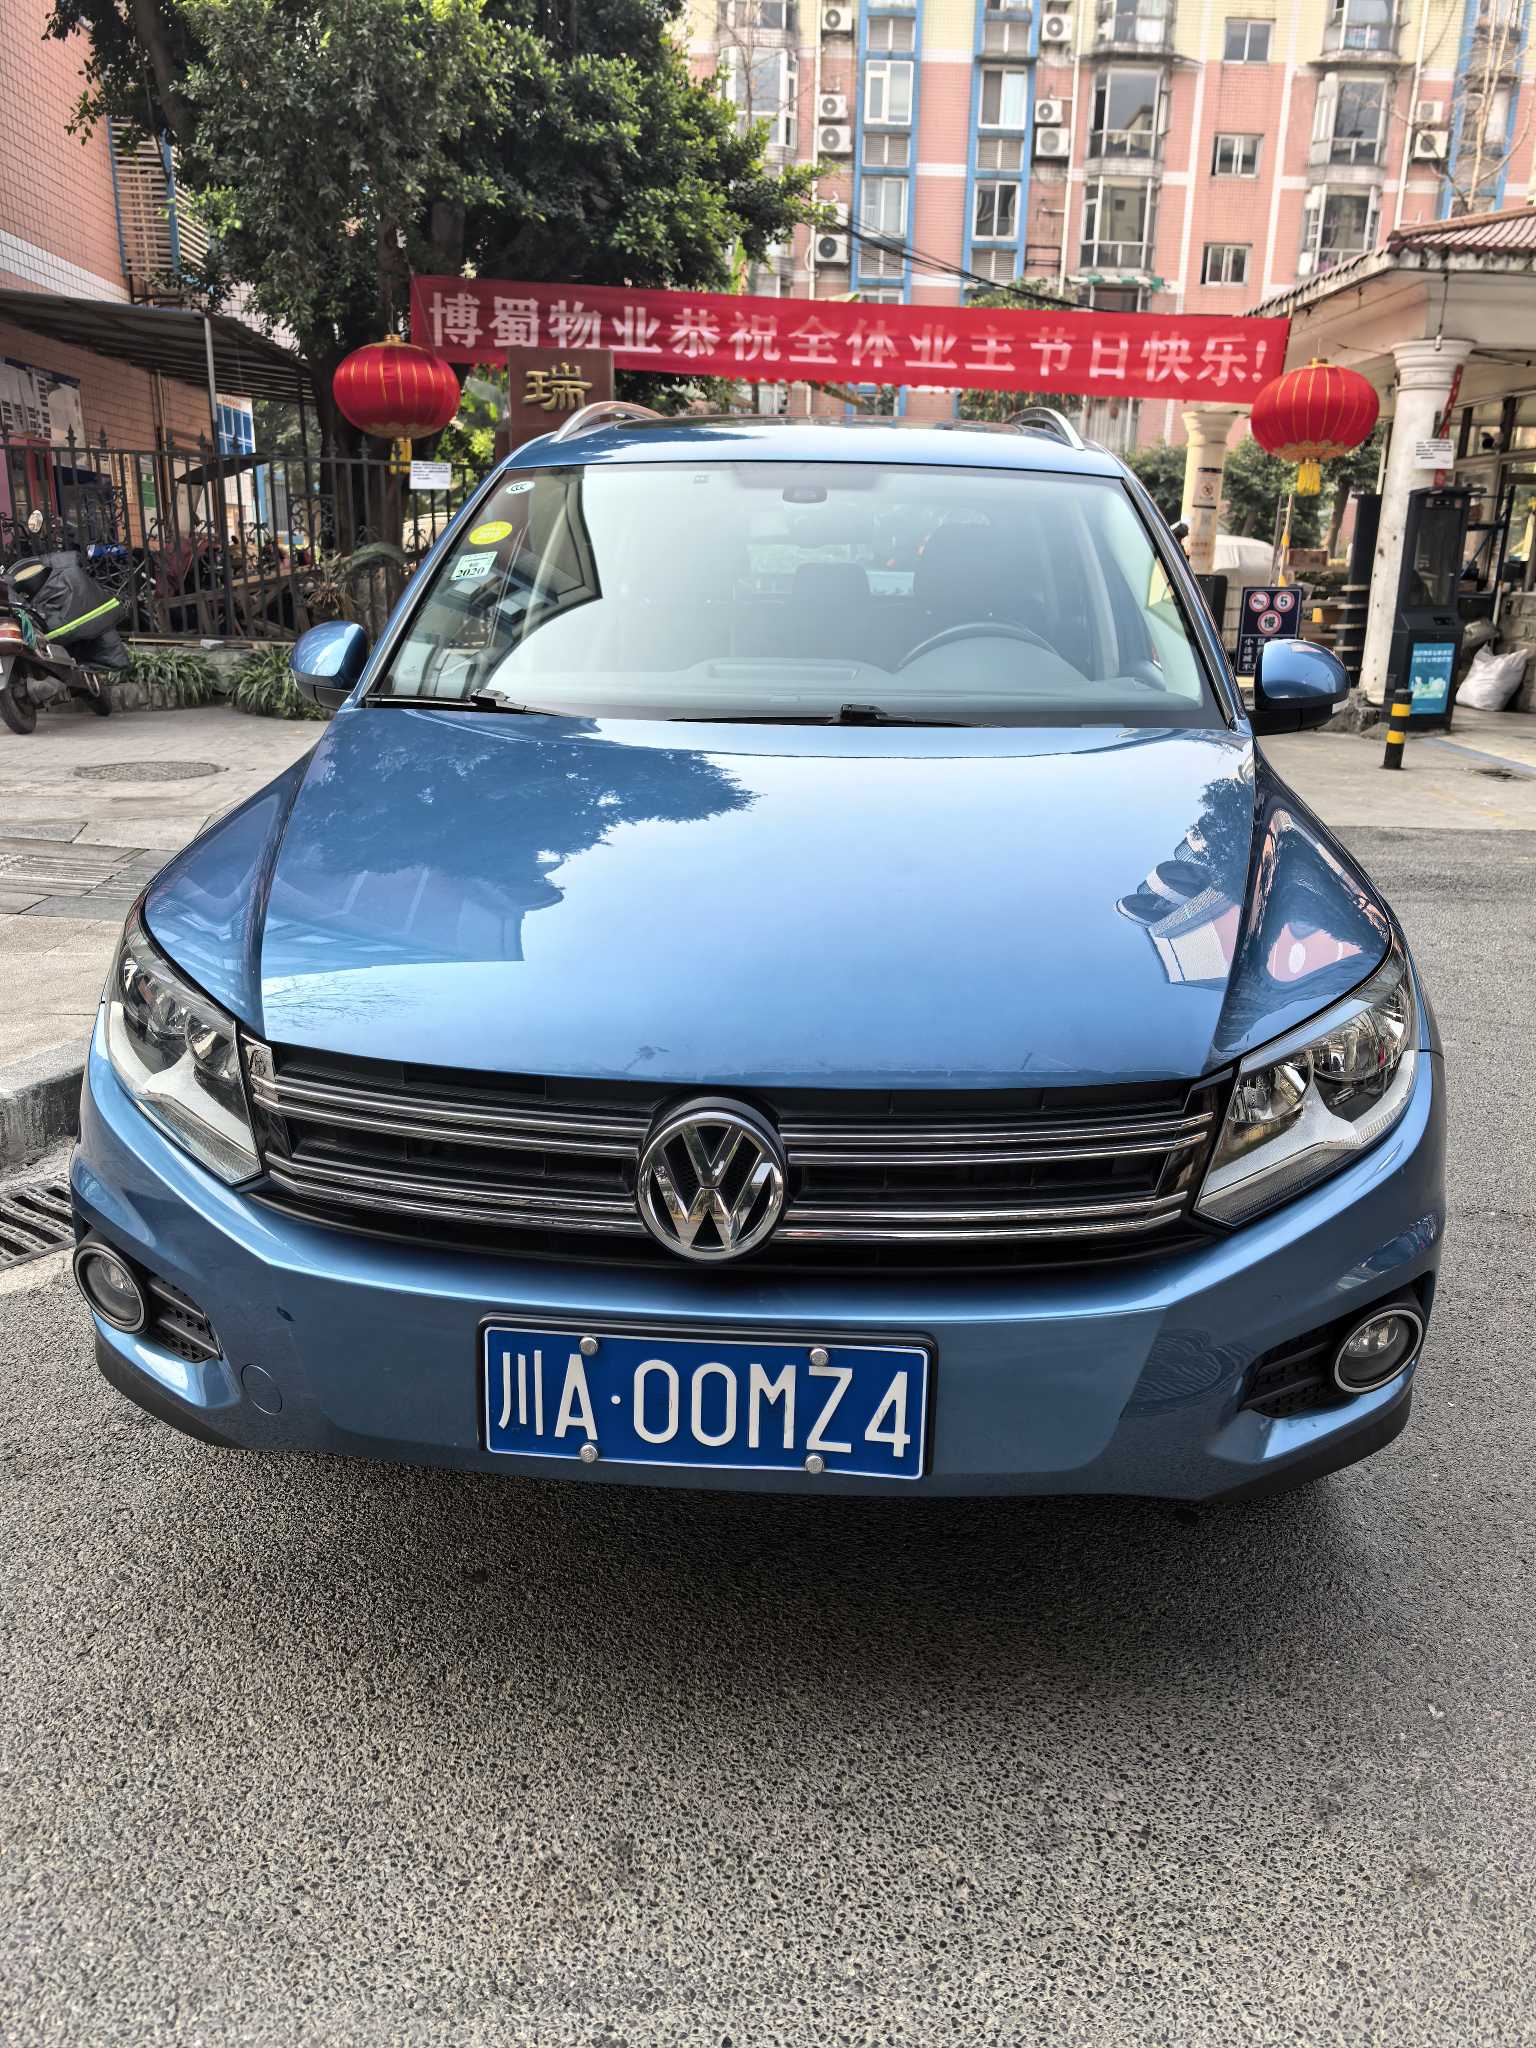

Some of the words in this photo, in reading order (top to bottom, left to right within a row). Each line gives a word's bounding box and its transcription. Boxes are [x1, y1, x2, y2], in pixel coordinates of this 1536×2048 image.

[429, 291, 1268, 387] 博蜀物业恭祝全体业主节日快乐!
[521, 361, 592, 412] 瑞
[455, 567, 485, 578] 2020
[1280, 596, 1287, 607] 5
[499, 1349, 911, 1458] 川A·00MZ4
